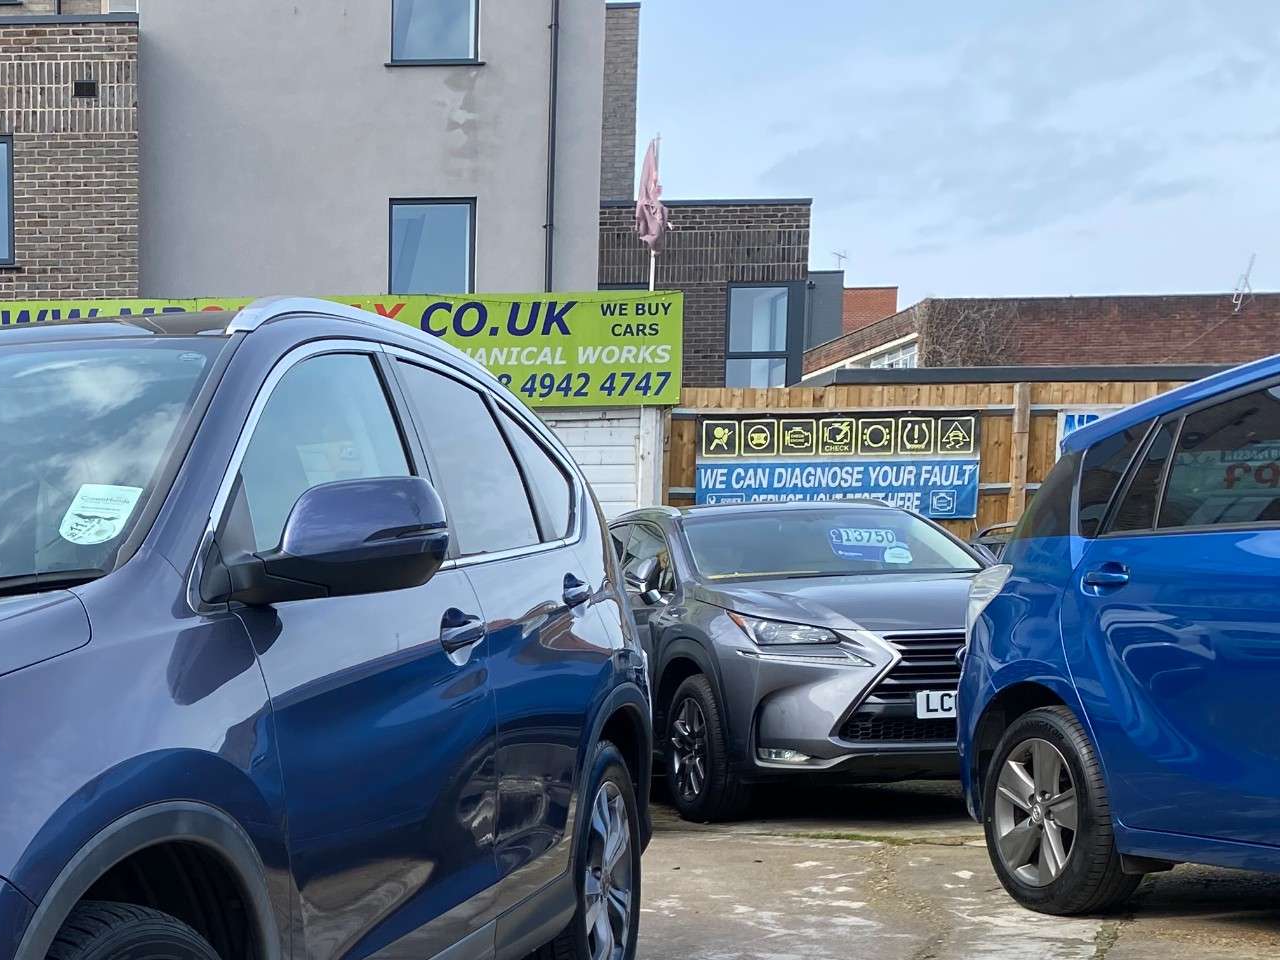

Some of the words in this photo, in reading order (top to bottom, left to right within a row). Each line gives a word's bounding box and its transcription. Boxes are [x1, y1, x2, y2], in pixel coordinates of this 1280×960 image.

[600, 303, 629, 317] WE
[635, 302, 673, 316] BUY
[611, 323, 659, 337] CARS
[577, 345, 673, 365] WORKS
[520, 372, 591, 398] 4942
[599, 371, 673, 397] 4747
[700, 467, 729, 489] WE
[731, 467, 770, 489] CAN
[773, 466, 864, 488] DIAGNOSE
[868, 465, 917, 487] YOUR
[919, 464, 973, 486] FAULT
[925, 692, 958, 713] LC
